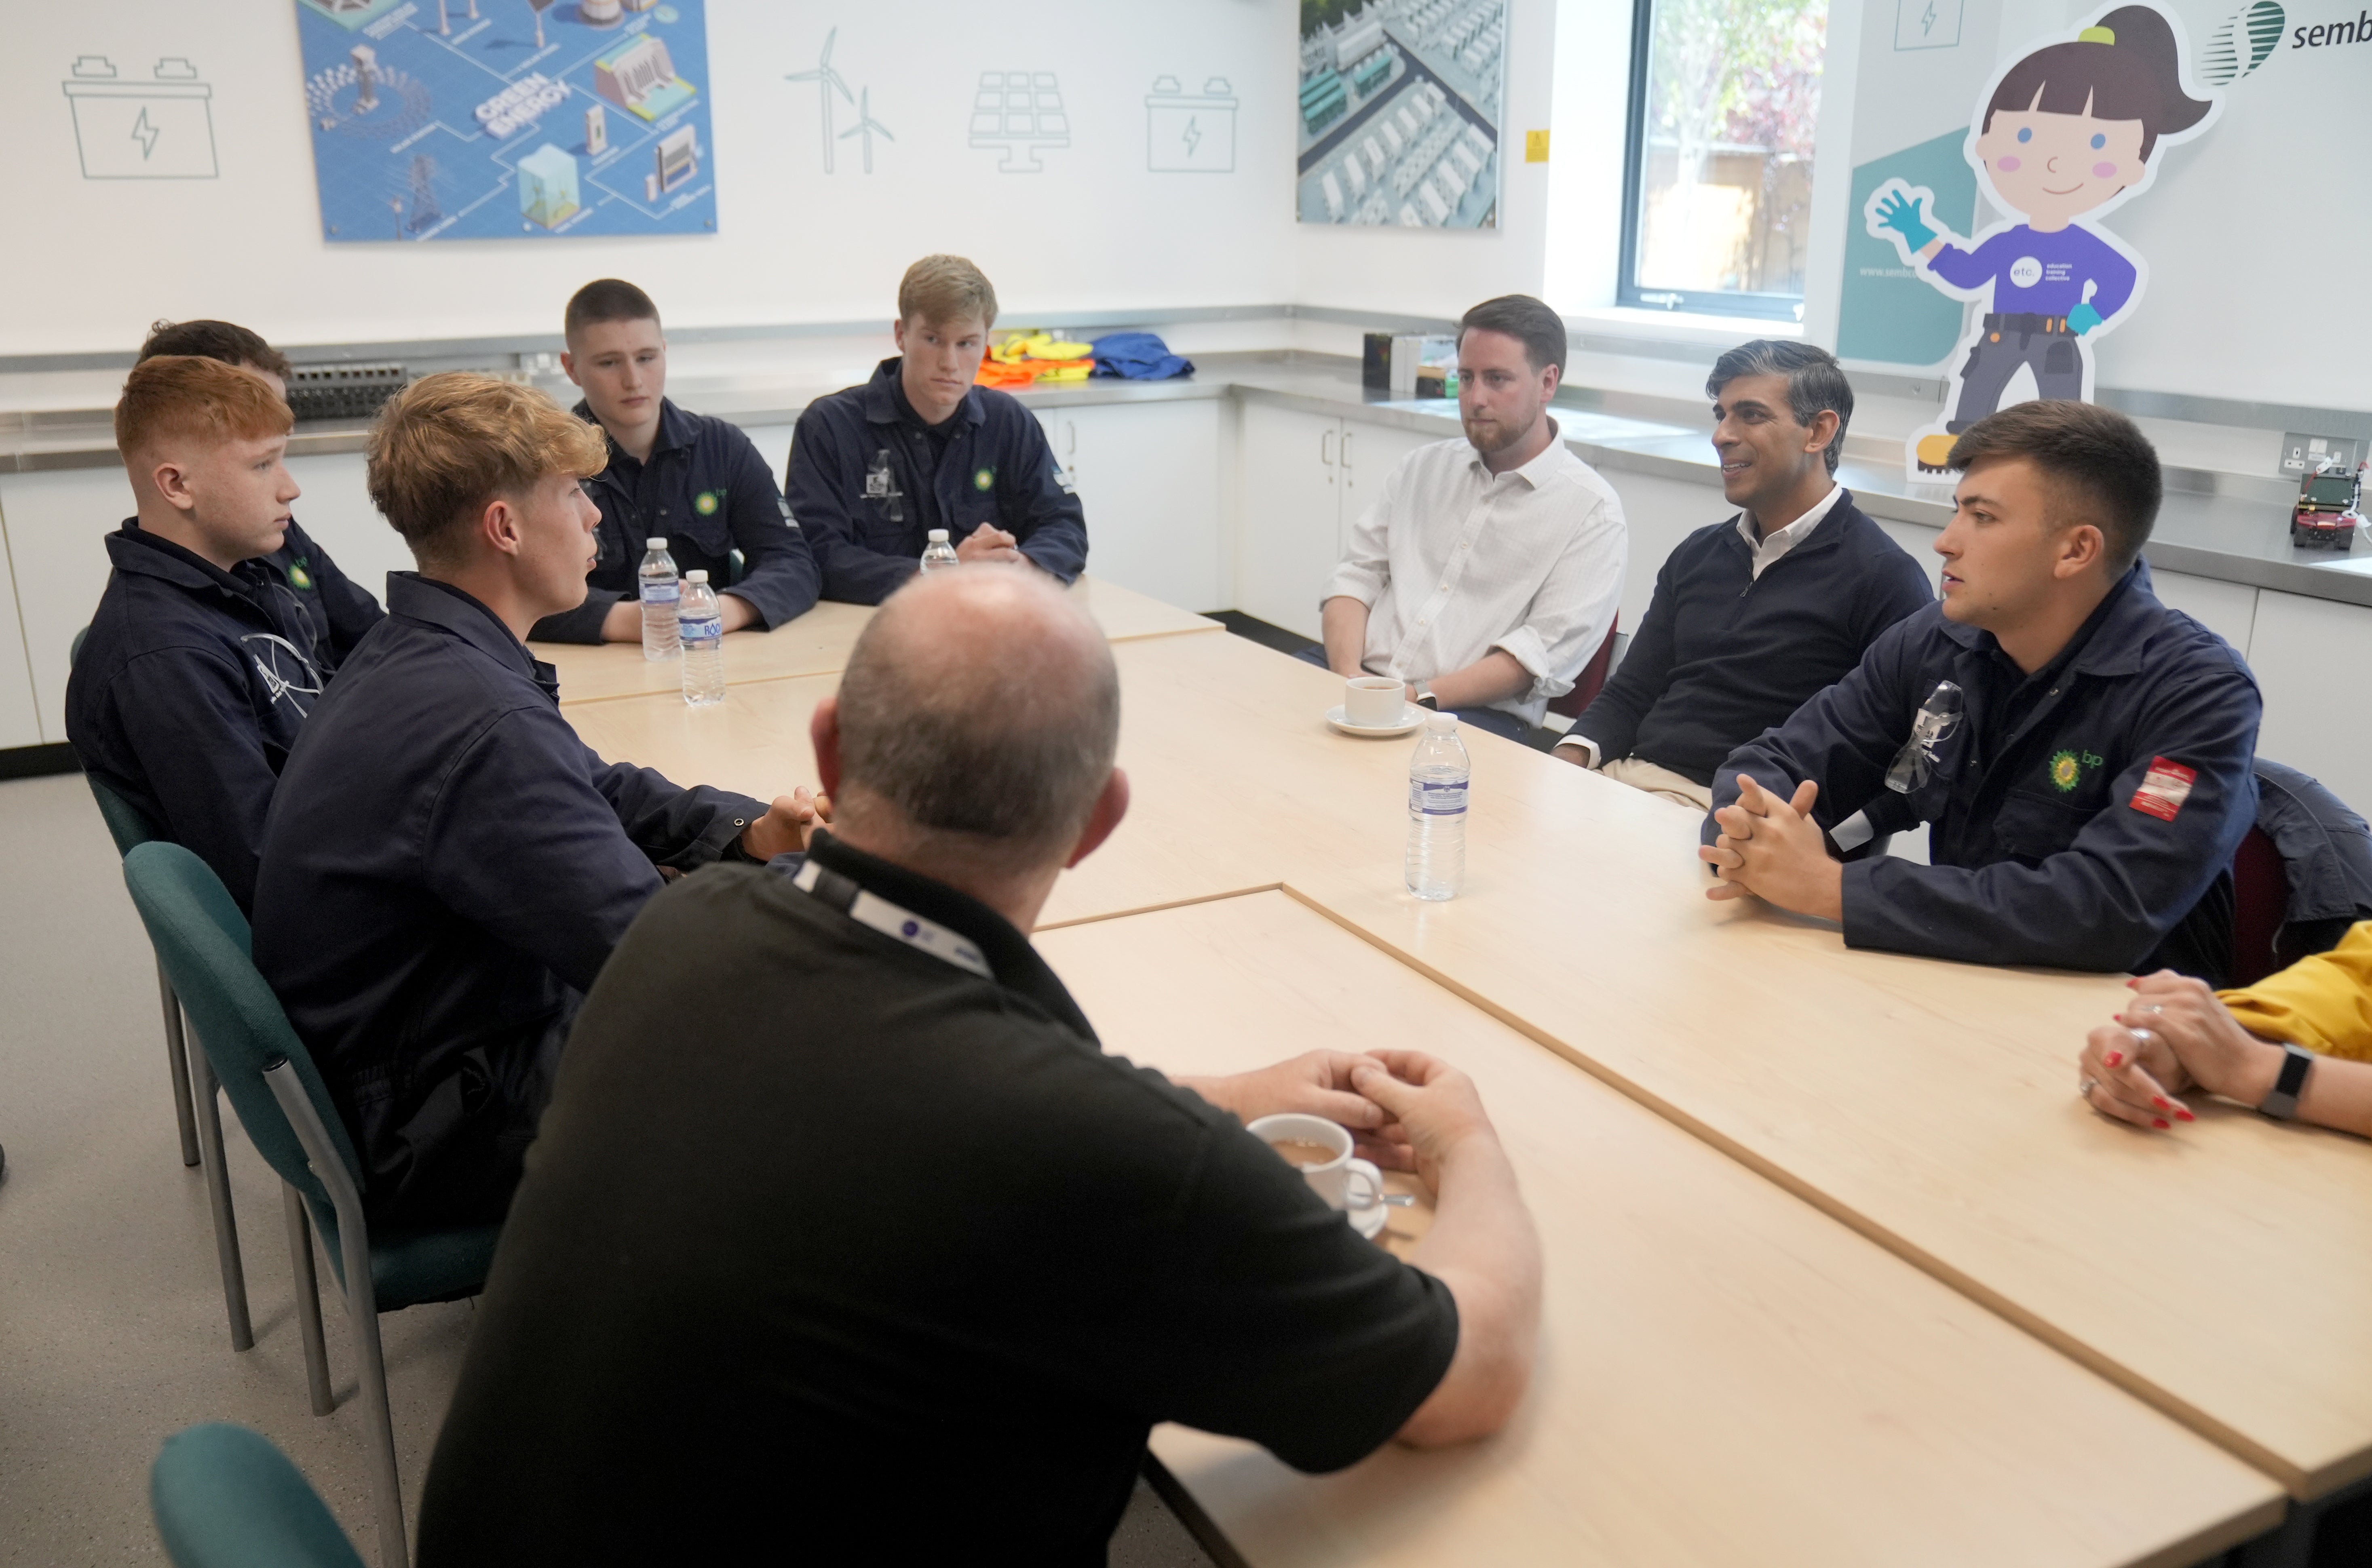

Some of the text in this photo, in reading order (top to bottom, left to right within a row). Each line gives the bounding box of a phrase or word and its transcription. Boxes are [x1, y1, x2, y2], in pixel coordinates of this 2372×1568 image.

[2292, 11, 2372, 49] semb
[475, 71, 549, 120] GREEN
[487, 79, 571, 138] ENERGY
[2081, 750, 2104, 769] bp
